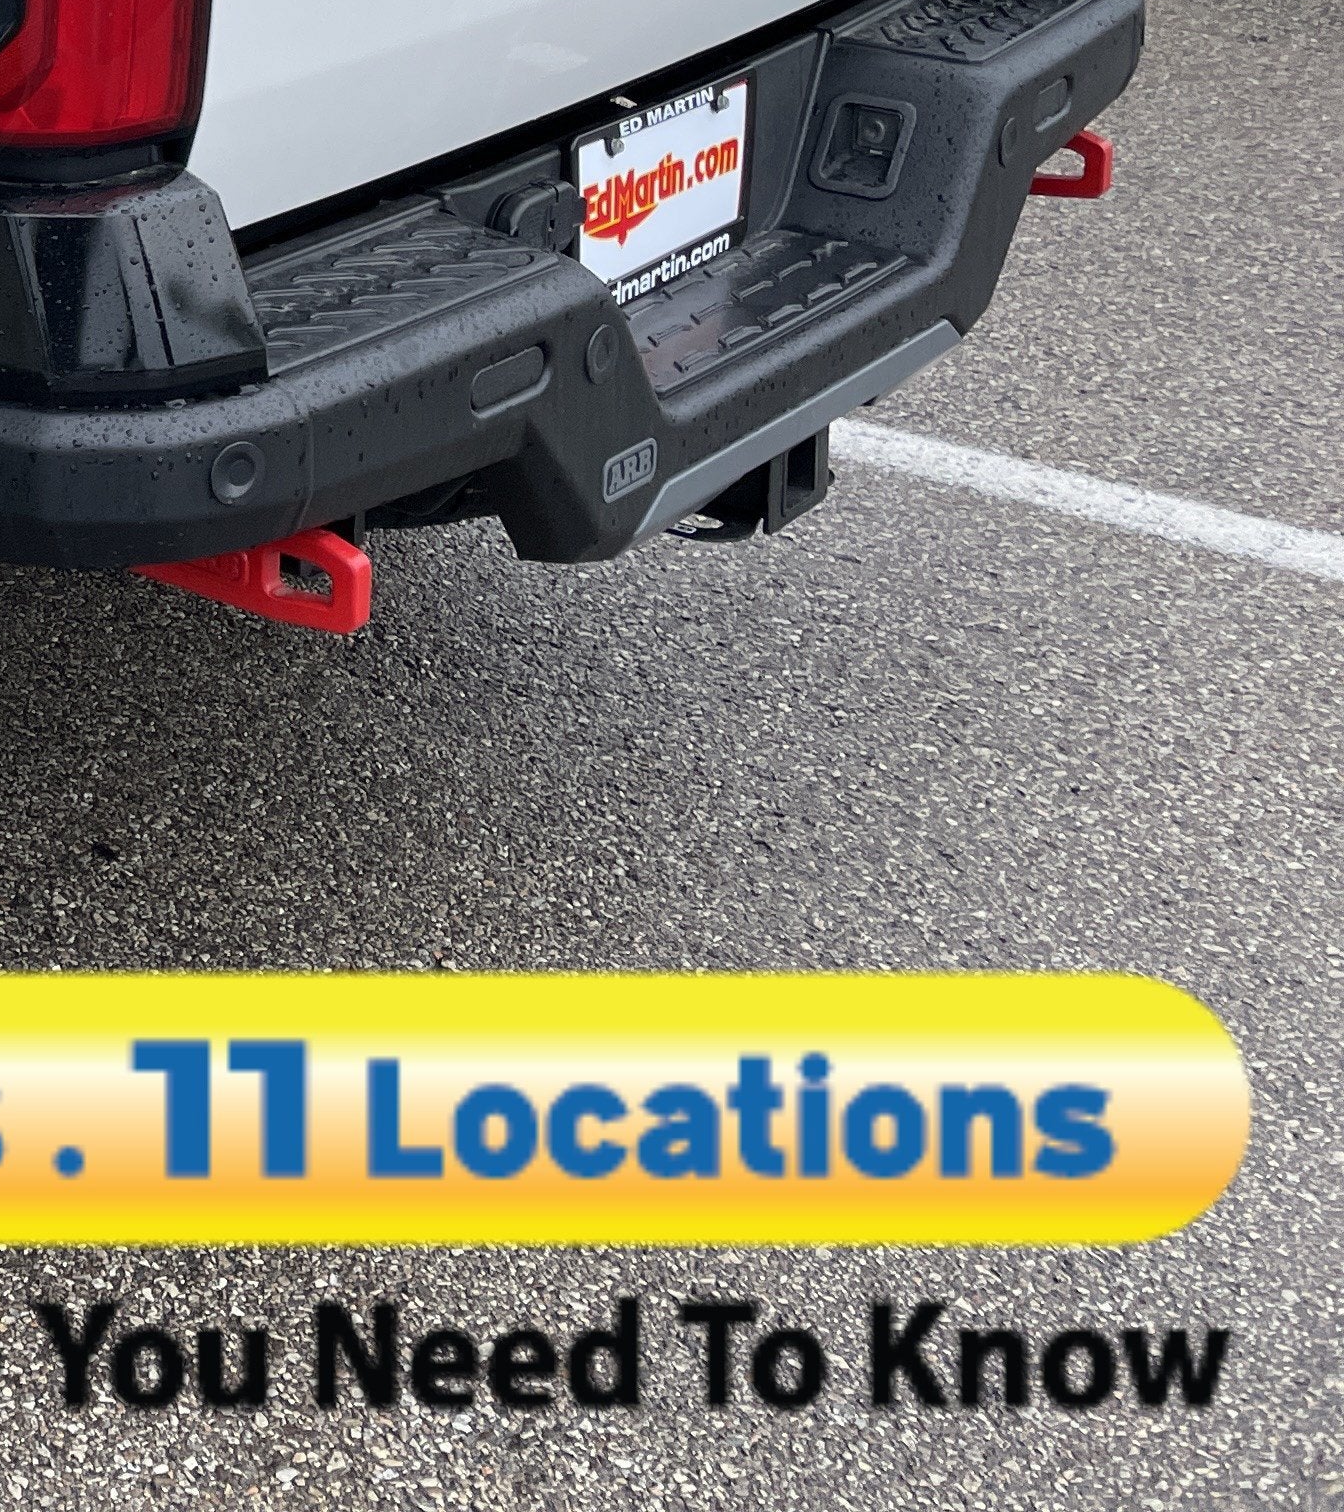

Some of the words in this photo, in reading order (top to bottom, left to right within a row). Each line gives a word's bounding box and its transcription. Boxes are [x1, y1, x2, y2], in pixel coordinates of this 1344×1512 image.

[618, 115, 644, 139] ED
[647, 86, 715, 129] MARTIN
[581, 136, 739, 234] EdMartin.com
[611, 232, 731, 306] dmartin.com
[608, 445, 654, 496] ARB
